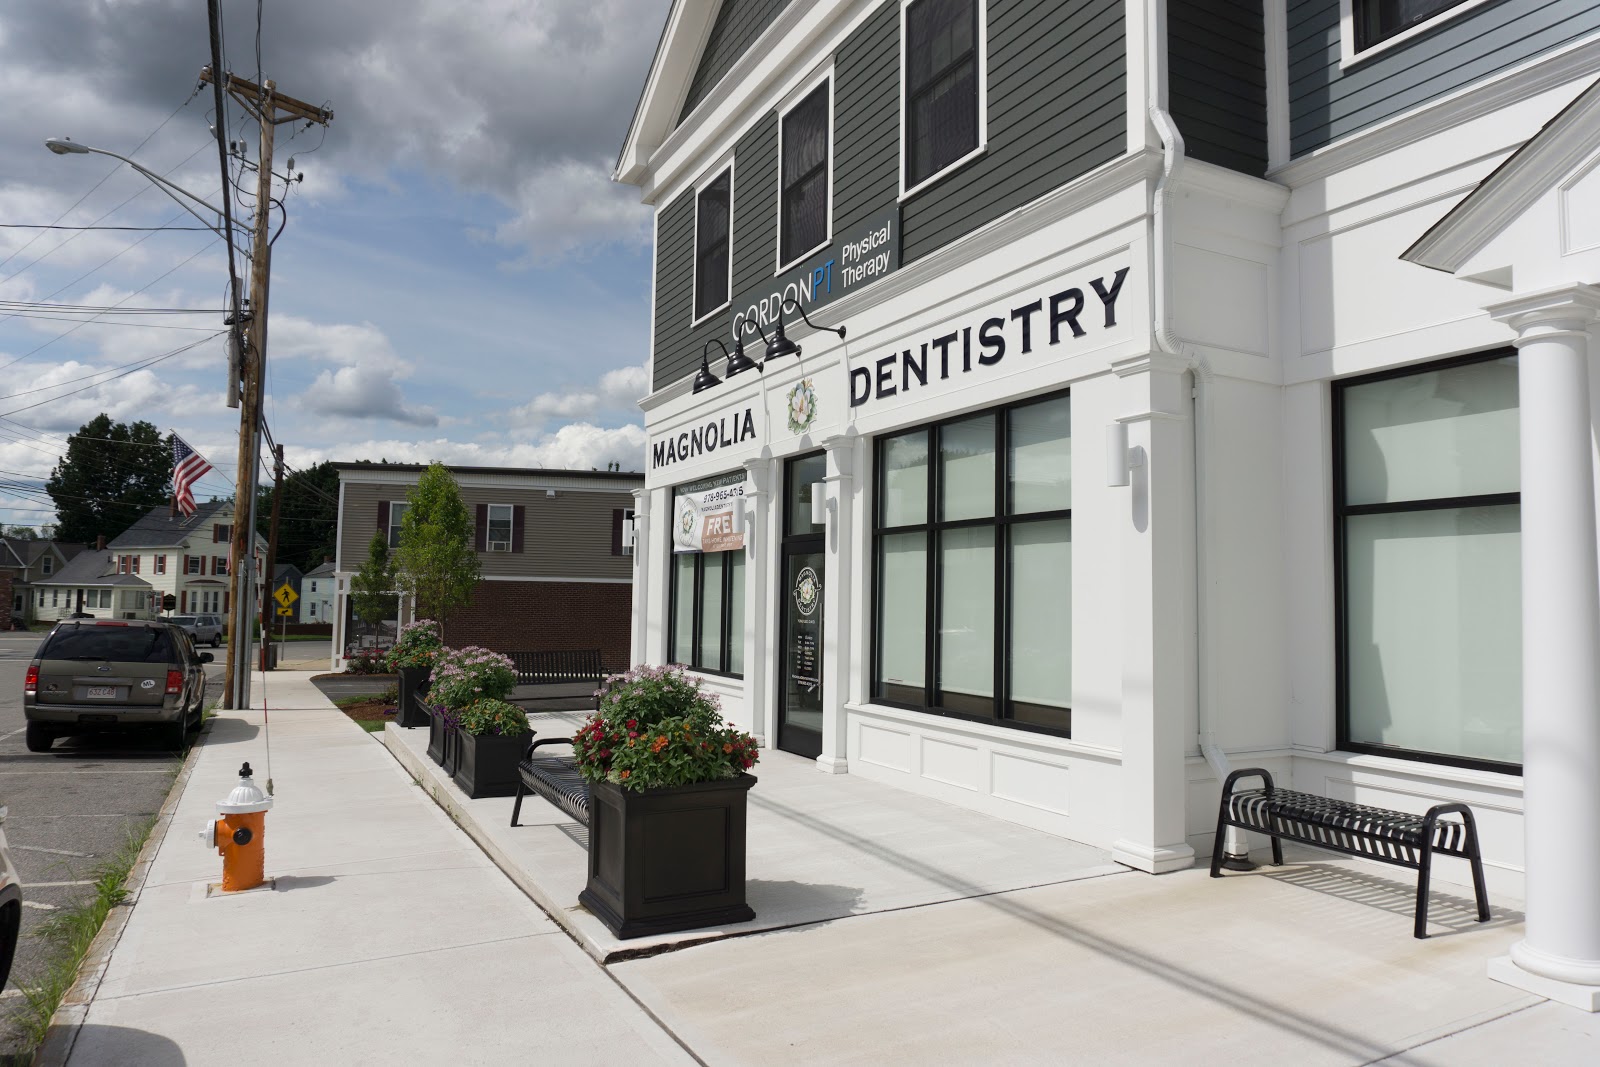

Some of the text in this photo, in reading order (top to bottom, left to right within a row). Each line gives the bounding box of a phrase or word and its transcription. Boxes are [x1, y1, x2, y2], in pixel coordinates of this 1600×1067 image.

[842, 220, 890, 265] Physical
[842, 250, 890, 288] Therapy
[849, 266, 1131, 408] DENTISTRY
[652, 408, 756, 469] MAGNOLIA
[722, 473, 745, 484] PATIENTS
[706, 514, 733, 536] FRE
